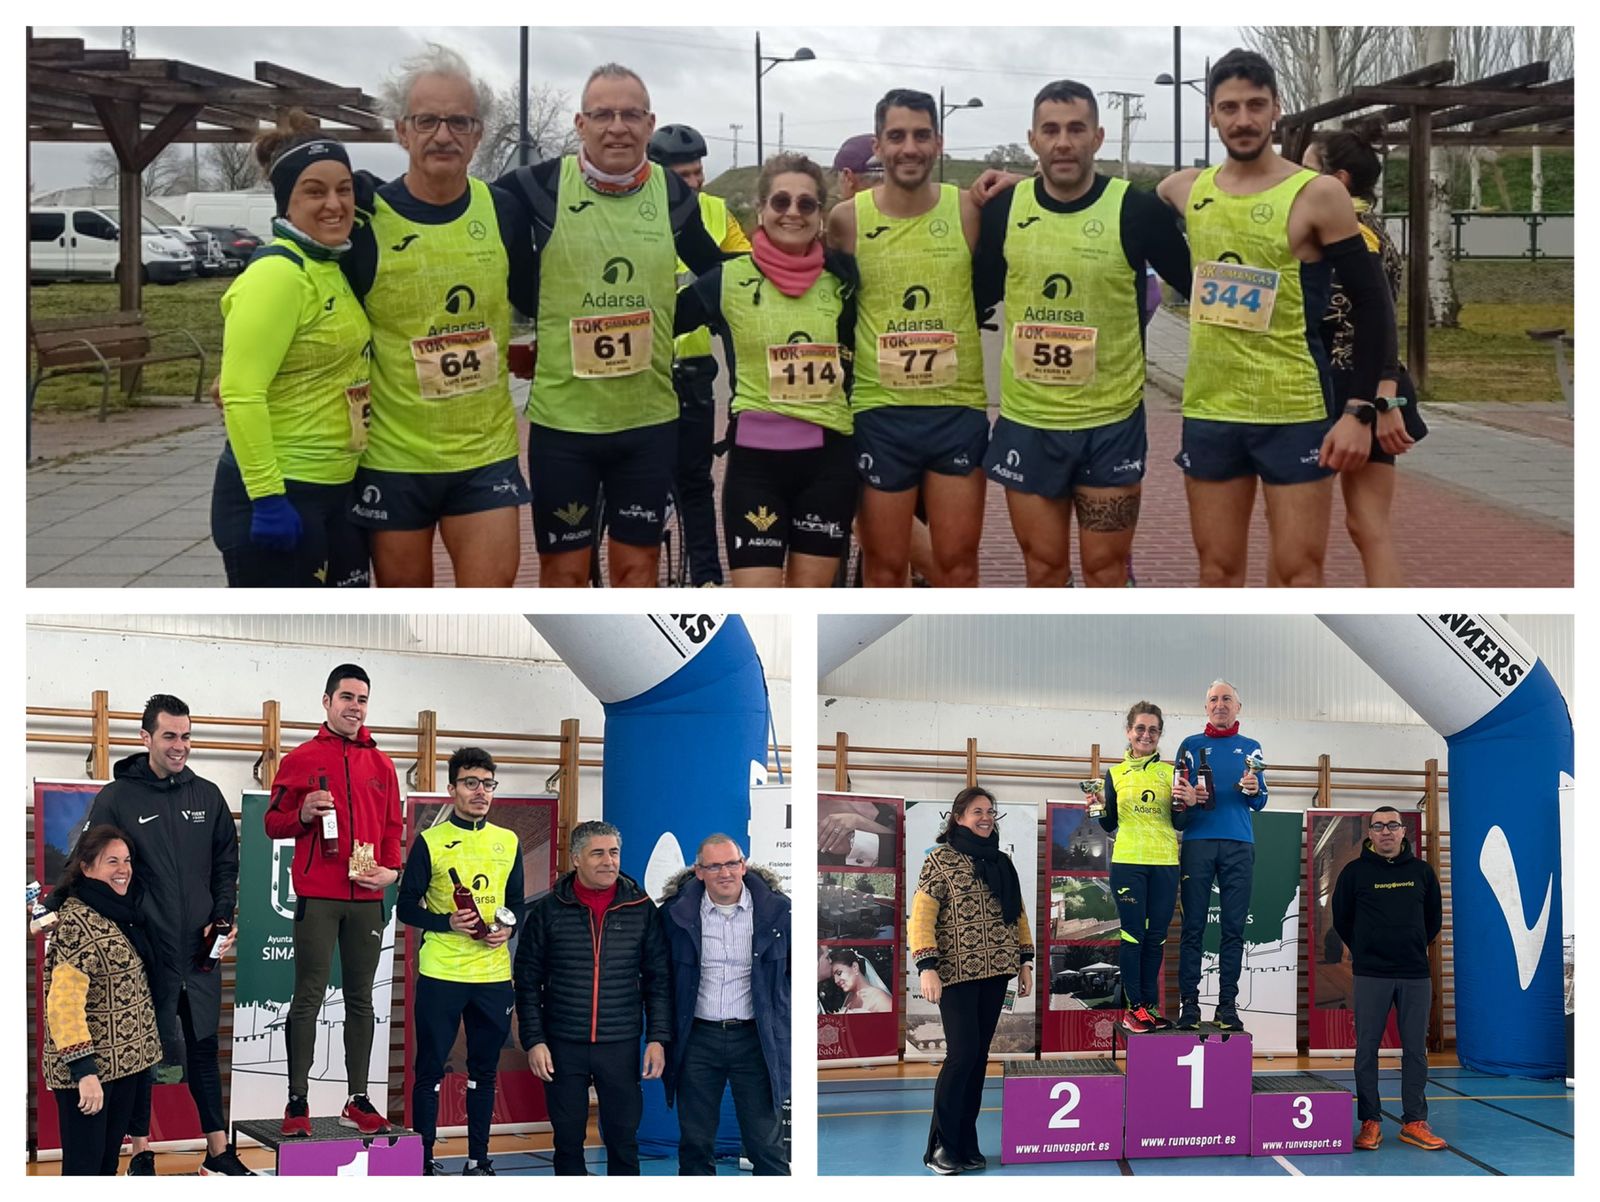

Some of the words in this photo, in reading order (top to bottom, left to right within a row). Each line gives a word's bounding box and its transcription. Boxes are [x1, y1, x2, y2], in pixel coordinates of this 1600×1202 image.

[581, 292, 648, 308] Adarsa
[1200, 281, 1262, 313] 344
[886, 317, 944, 333] Adarsa
[1023, 306, 1085, 322] Adarsa
[575, 320, 602, 334] 10K
[593, 332, 632, 360] 61
[772, 348, 799, 361] 10K
[882, 337, 908, 349] 10K
[440, 350, 481, 377] 64
[899, 349, 938, 373] 77
[1033, 343, 1073, 368] 58
[782, 362, 837, 386] 114
[1134, 804, 1162, 815] Adarsa
[1177, 1045, 1205, 1109] 1
[1048, 1081, 1081, 1129] 2
[1292, 1096, 1314, 1129] 3
